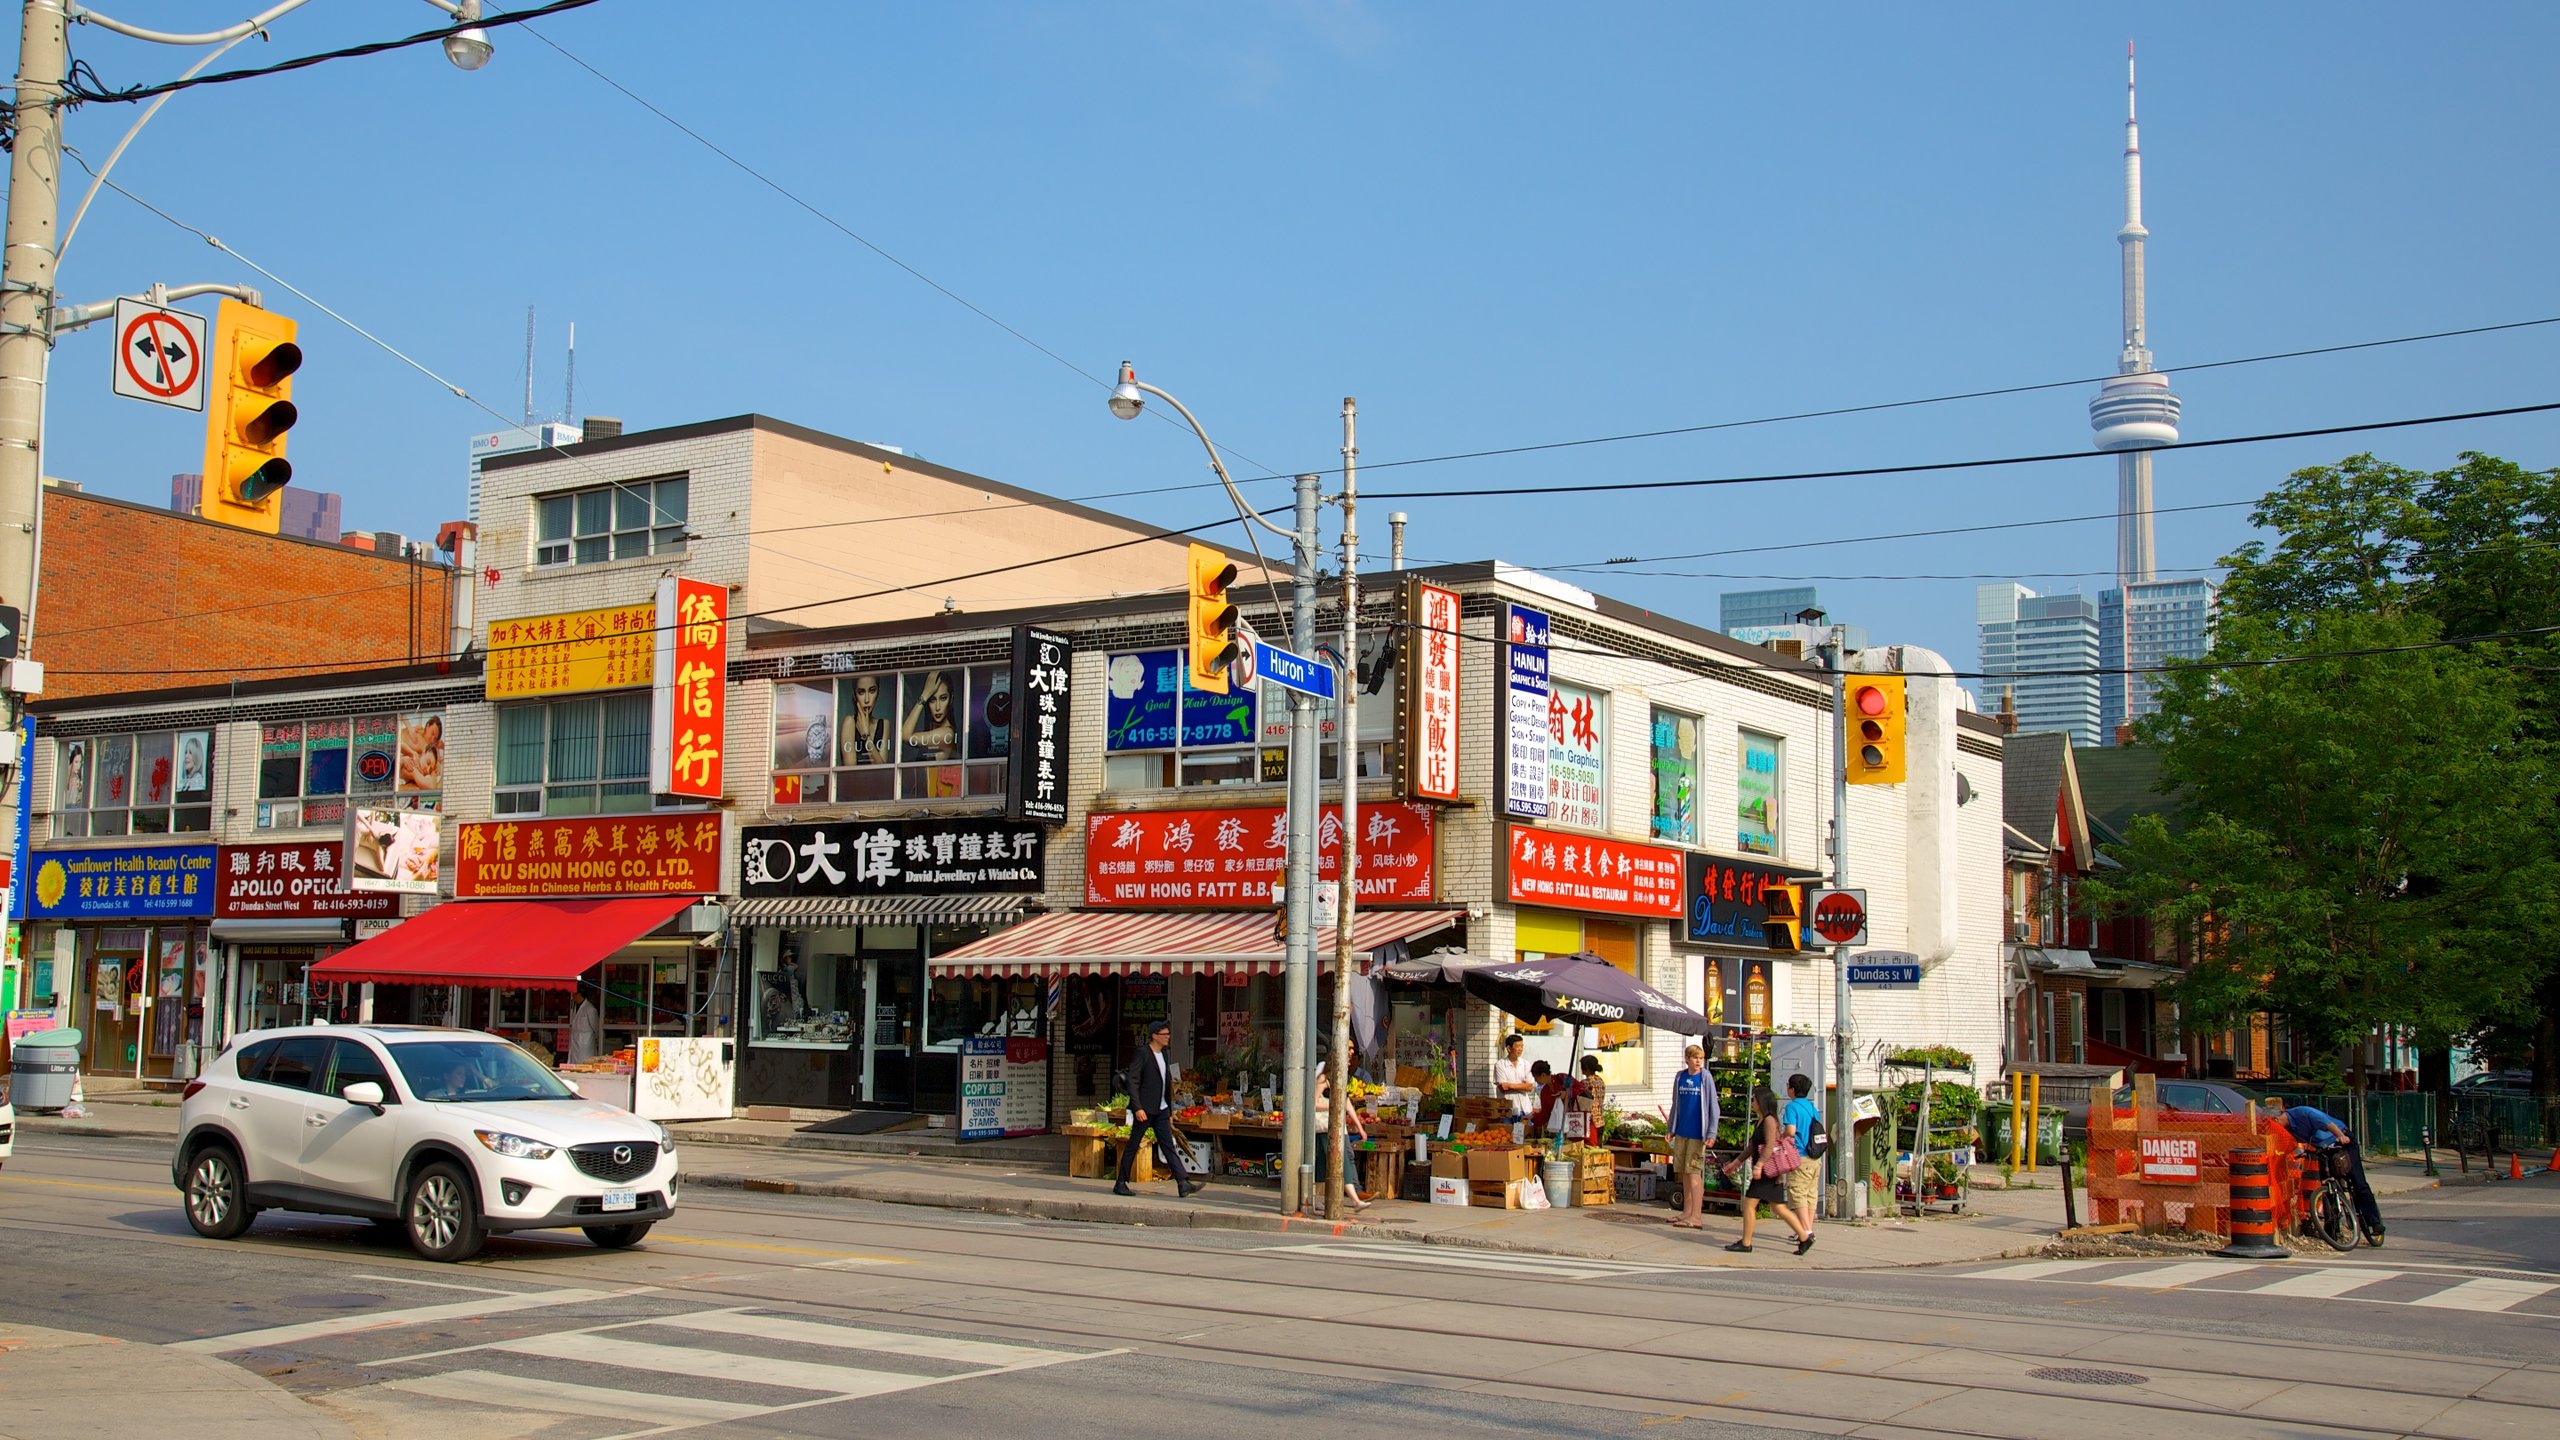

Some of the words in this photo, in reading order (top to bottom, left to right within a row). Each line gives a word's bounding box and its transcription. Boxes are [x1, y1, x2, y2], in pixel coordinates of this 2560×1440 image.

[473, 440, 488, 448] BMO
[557, 432, 576, 442] BMO
[1270, 651, 1304, 682] Huron
[1307, 664, 1315, 676] St
[1514, 651, 1545, 674] HANLIN
[1029, 664, 1068, 695] 大偉
[675, 593, 723, 788] 僑信行
[1145, 699, 1170, 712] Good
[1184, 697, 1207, 708] Hair
[1210, 695, 1243, 707] Design
[844, 739, 891, 752] GUCCI
[909, 732, 958, 747] GUCCI
[360, 758, 389, 775] OPEN
[1568, 750, 1600, 769] Graphics
[1264, 767, 1284, 776] TAX
[1548, 764, 1595, 785] 16-595-5050
[67, 857, 112, 873] Sunflower
[114, 855, 145, 872] Health
[147, 856, 178, 872] Beauty
[180, 854, 212, 870] Centre
[229, 848, 343, 876] 聯邦眼鏡
[797, 828, 901, 887] 大偉
[1521, 838, 1633, 881] 新鴻發美食軒
[478, 863, 512, 881] KYU
[517, 861, 562, 881] SHON
[567, 858, 616, 879] HONG
[621, 859, 651, 878] CO.
[656, 858, 694, 876] LTD.
[905, 869, 932, 883] David
[933, 869, 976, 885] Jewellery
[977, 869, 986, 881] &
[988, 867, 1018, 881] Watch
[1019, 866, 1037, 879] Co.
[230, 878, 284, 897] APOLLO
[384, 880, 426, 890] 344-1086
[474, 882, 527, 897] Specializes
[530, 881, 539, 893] In
[542, 879, 580, 893] Chinese
[583, 879, 611, 892] Herbs
[615, 880, 622, 891] &
[626, 878, 659, 891] Health
[662, 878, 696, 890] Foods.
[1115, 883, 1146, 899] NEW
[1151, 883, 1192, 899] HONG
[1197, 882, 1237, 897] FATT
[1521, 878, 1536, 892] NEW
[1537, 879, 1554, 895] HONG
[1556, 882, 1573, 897] FATT
[9, 877, 18, 912] Centre
[144, 899, 154, 908] Tel:
[154, 899, 165, 908] 416
[166, 899, 177, 908] 599
[178, 898, 193, 908] 1688
[81, 901, 91, 910] 435
[93, 900, 114, 910] Dundas
[122, 899, 130, 909] W.
[228, 901, 240, 911] 437
[241, 900, 264, 911] Dundas
[265, 900, 283, 911] Street
[284, 899, 300, 911] West
[313, 899, 329, 910] Tel:
[330, 899, 388, 910] 416-593-0159
[364, 919, 390, 928] APOLLO
[1692, 895, 1738, 937] David
[762, 974, 787, 982] GUCCI
[1854, 968, 1889, 980] Dundas
[1892, 971, 1900, 980] St
[1903, 968, 1913, 980] W
[1571, 998, 1624, 1019] SAPPORO
[51, 1065, 66, 1073] Litter
[965, 1082, 988, 1096] COPY
[967, 1098, 1001, 1108] PRINTING
[972, 1108, 996, 1118] SIGNS
[968, 1117, 999, 1128] STAMPS
[2142, 1139, 2197, 1158] DANGER
[1440, 1181, 1451, 1190] sk
